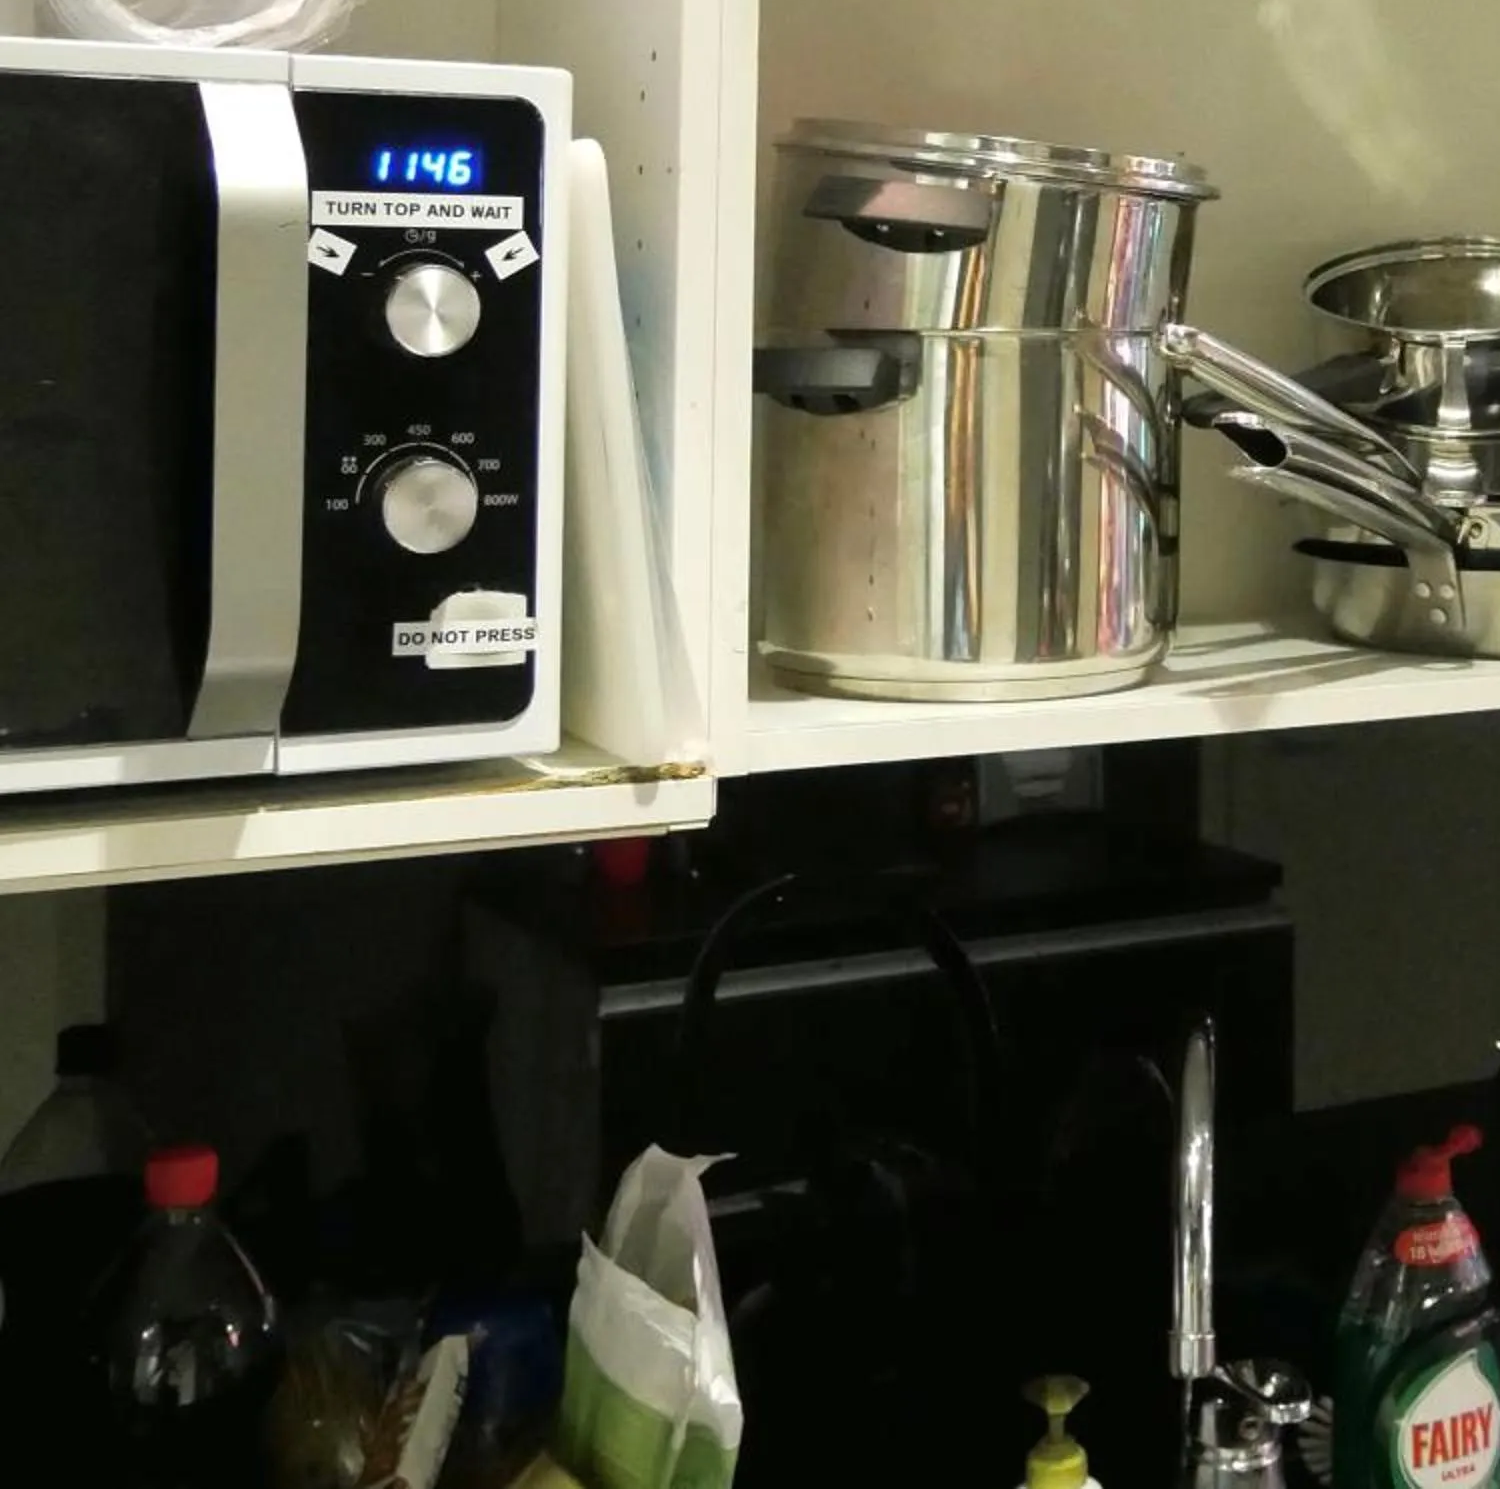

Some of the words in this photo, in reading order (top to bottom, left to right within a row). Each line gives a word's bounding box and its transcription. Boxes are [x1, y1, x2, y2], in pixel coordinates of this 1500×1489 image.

[326, 200, 378, 217] TURN
[384, 202, 421, 217] TOP
[427, 204, 465, 219] AND
[470, 205, 513, 220] WAIT
[325, 498, 349, 511] 100
[399, 631, 426, 646] DO
[431, 629, 471, 644] NOT
[475, 627, 535, 643] PRESS
[1412, 1401, 1494, 1468] FAIRY
